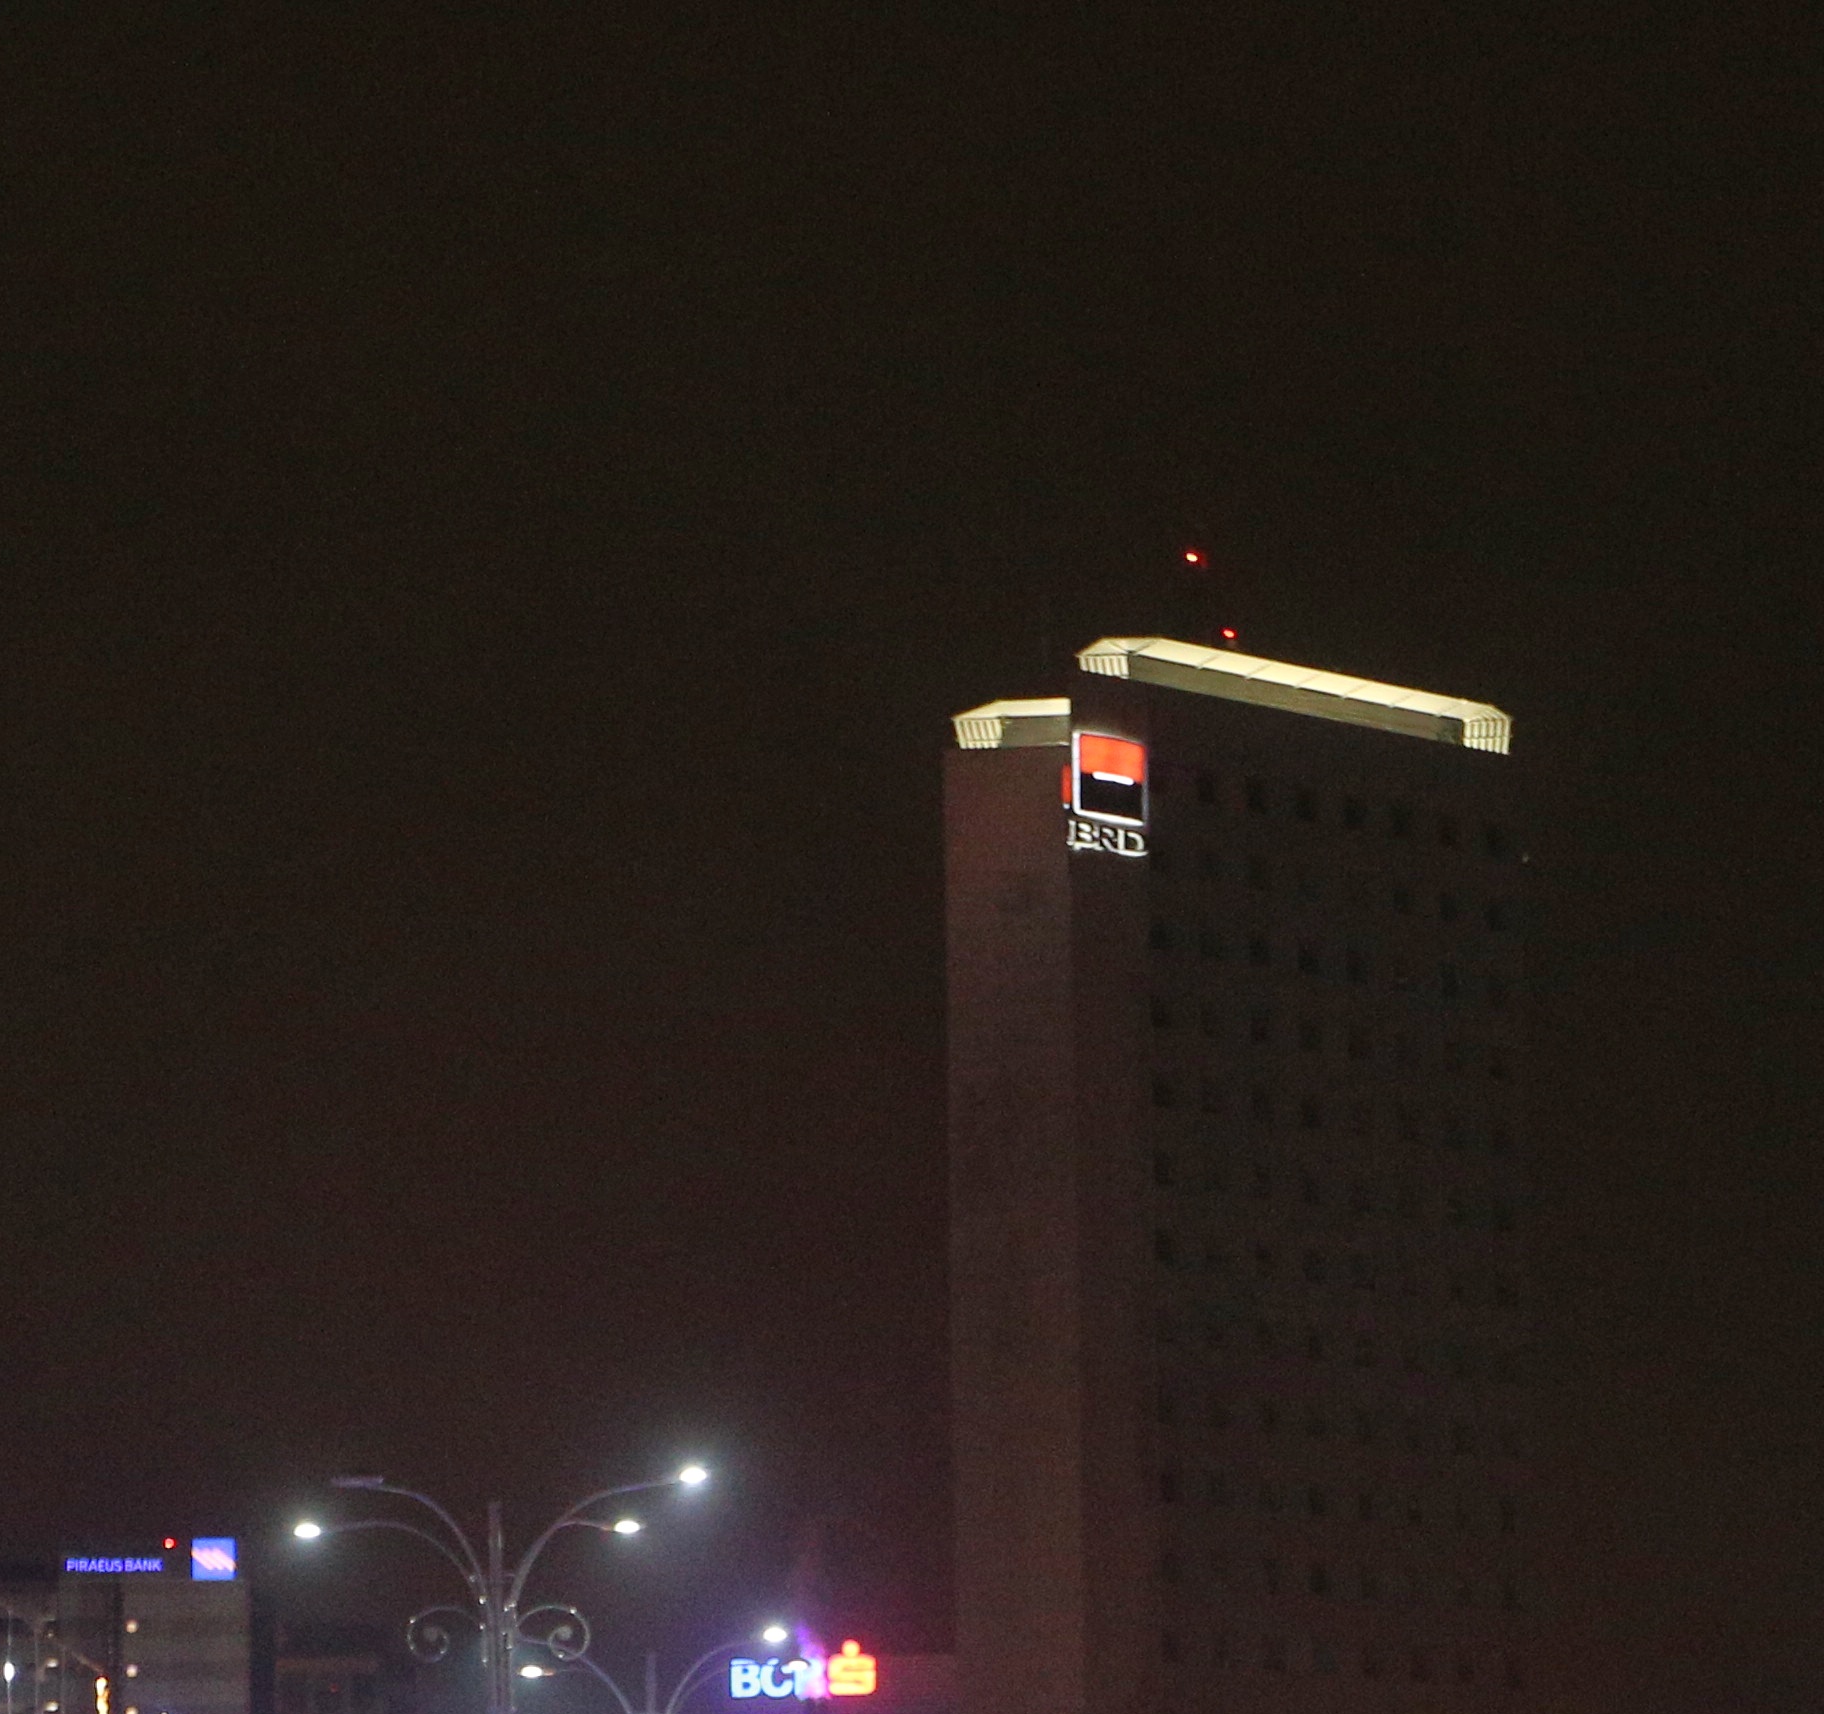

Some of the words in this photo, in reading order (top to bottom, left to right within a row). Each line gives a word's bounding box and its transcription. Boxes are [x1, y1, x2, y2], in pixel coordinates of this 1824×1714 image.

[1066, 819, 1148, 857] BRD
[65, 1558, 123, 1574] PIRAEUS
[125, 1558, 164, 1574] BANK
